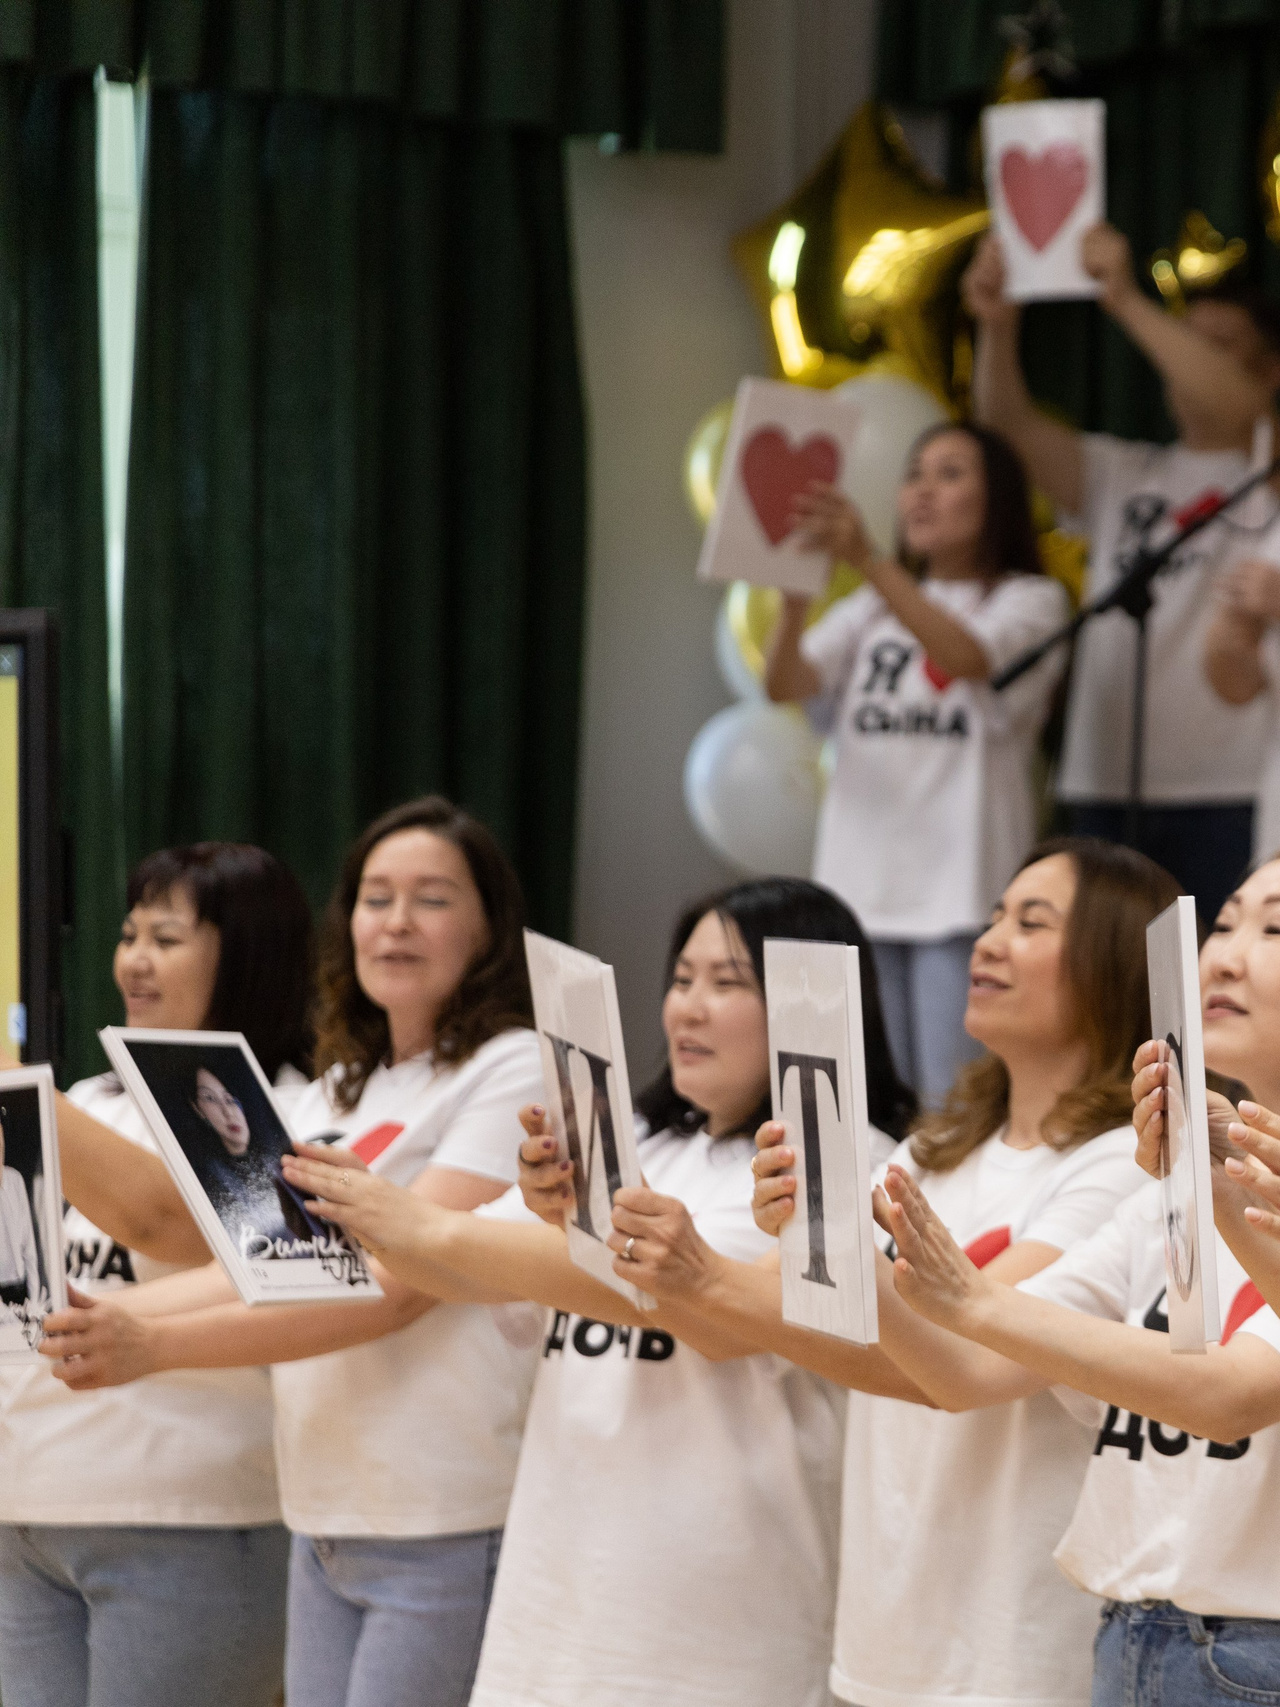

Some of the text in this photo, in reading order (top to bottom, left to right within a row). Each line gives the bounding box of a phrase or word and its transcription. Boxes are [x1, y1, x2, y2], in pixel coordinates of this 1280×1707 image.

[863, 640, 914, 694] Я
[853, 703, 969, 741] СЫНА
[777, 1050, 841, 1289] Т
